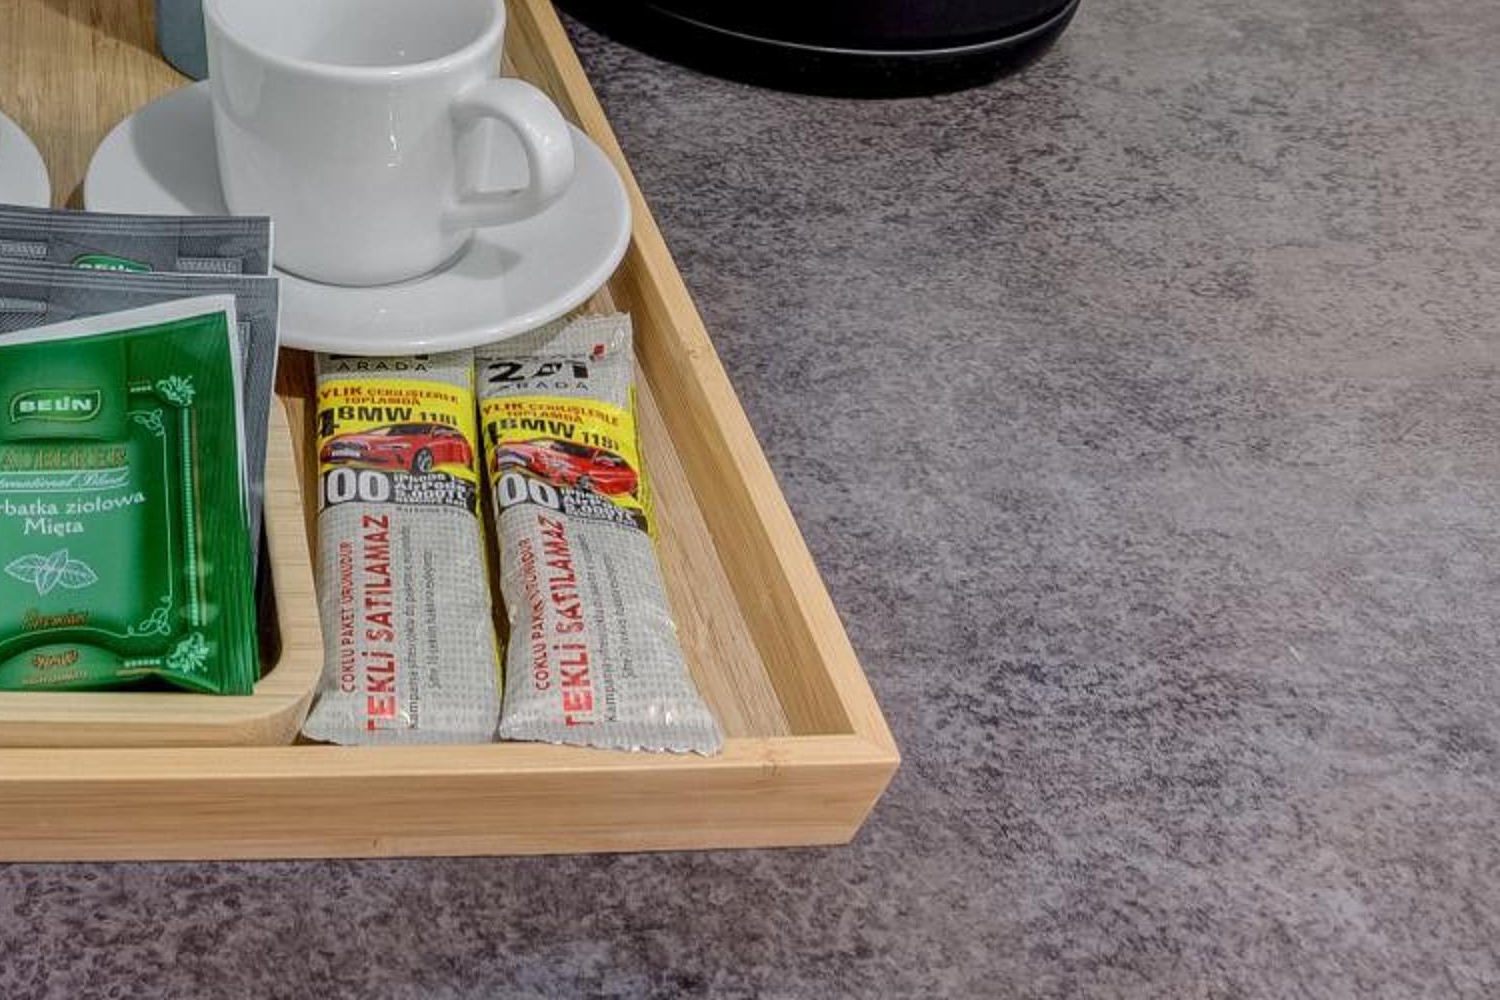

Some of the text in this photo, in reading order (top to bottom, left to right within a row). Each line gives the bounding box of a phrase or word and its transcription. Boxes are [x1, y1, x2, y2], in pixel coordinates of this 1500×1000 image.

[338, 361, 429, 373] ARADA
[338, 406, 413, 423] BMW
[501, 417, 576, 440] BMW
[321, 467, 390, 505] 00
[494, 472, 560, 509] 00
[23, 517, 85, 537] Mięta
[537, 513, 585, 634] SATILAMAZ
[340, 607, 355, 646] PAKET
[362, 514, 396, 733] TEKLİ SATILAMAZ
[553, 643, 593, 728] TEKLİ
